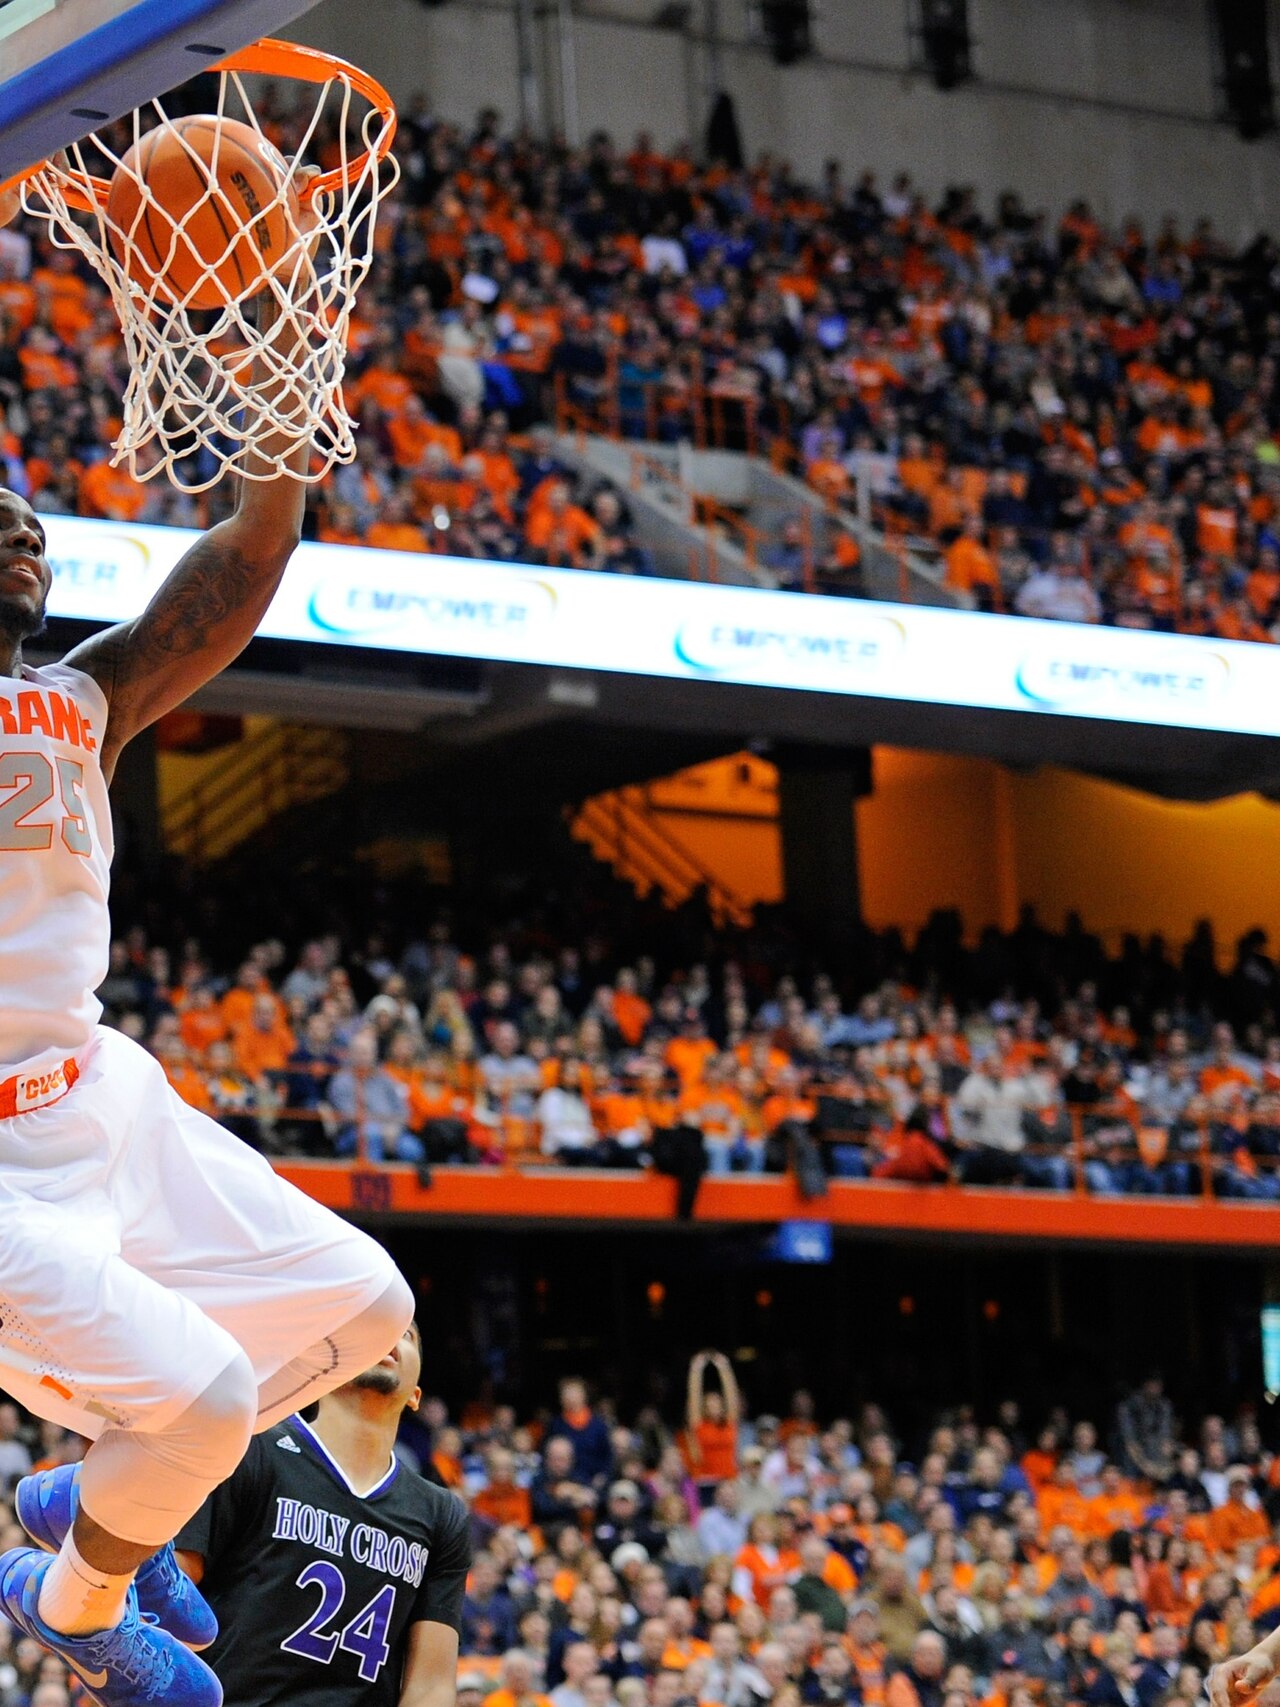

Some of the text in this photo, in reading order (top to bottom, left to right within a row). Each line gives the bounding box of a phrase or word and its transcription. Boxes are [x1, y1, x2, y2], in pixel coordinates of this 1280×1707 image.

[345, 587, 529, 629] EMPOWER
[272, 1497, 429, 1588] HOLY CROSS
[280, 1560, 397, 1683] 24
